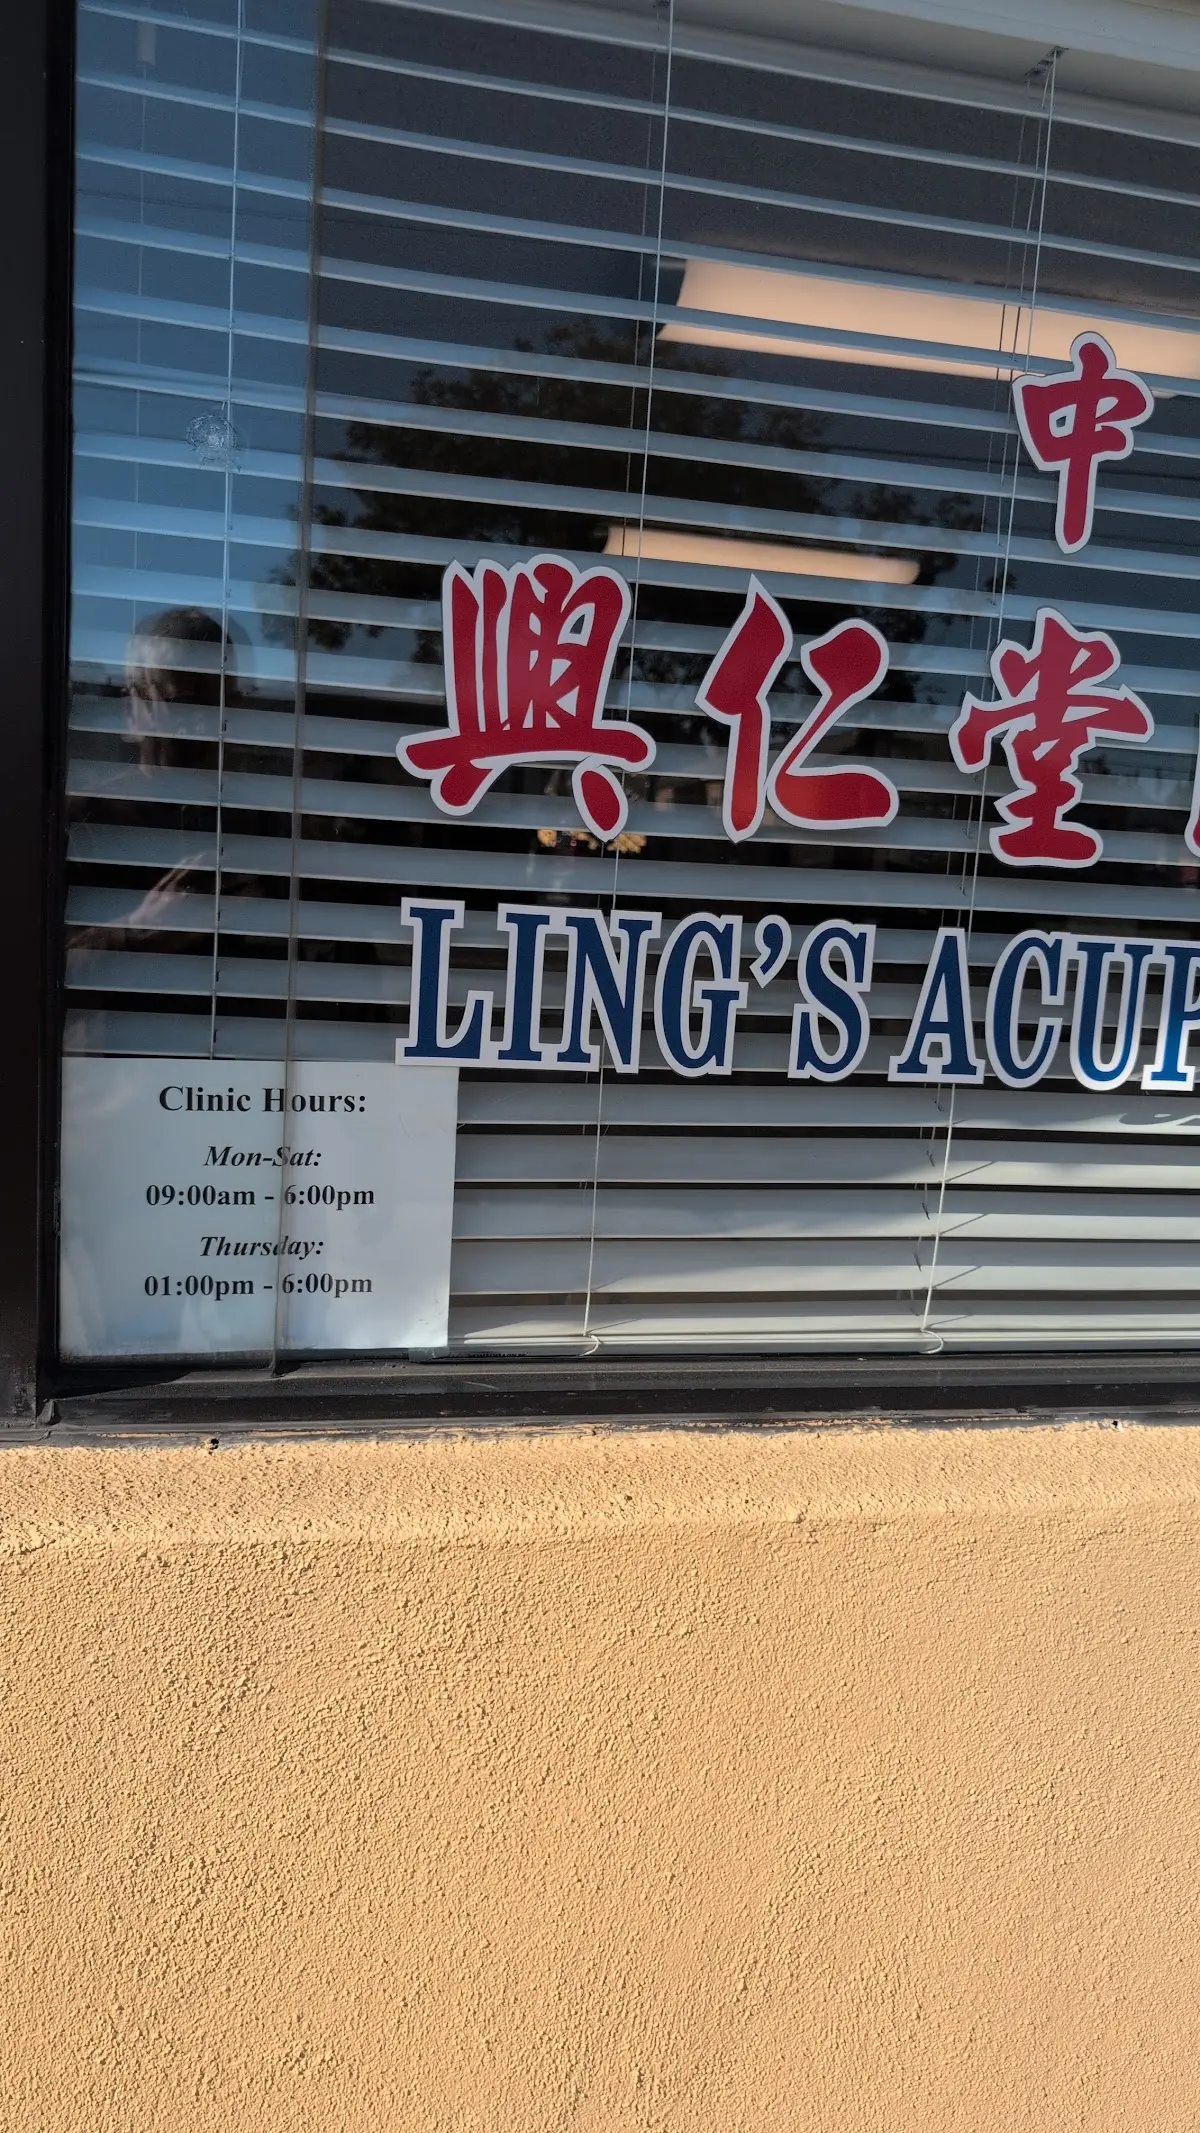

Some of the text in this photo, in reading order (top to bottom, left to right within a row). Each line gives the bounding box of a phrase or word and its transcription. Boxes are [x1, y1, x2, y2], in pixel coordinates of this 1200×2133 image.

[1020, 340, 1147, 546] 中
[403, 560, 1200, 860] 興仁堂
[402, 905, 1200, 1084] LING'S ACUP
[158, 1086, 367, 1114] Clinic Hours:
[202, 1145, 322, 1168] Mon-Sat:
[145, 1185, 257, 1206] 09:00am
[283, 1184, 376, 1210] 6:00pm
[200, 1236, 325, 1259] Thursday:
[143, 1275, 255, 1301] 01:00pm
[281, 1272, 374, 1298] 6:00pm
